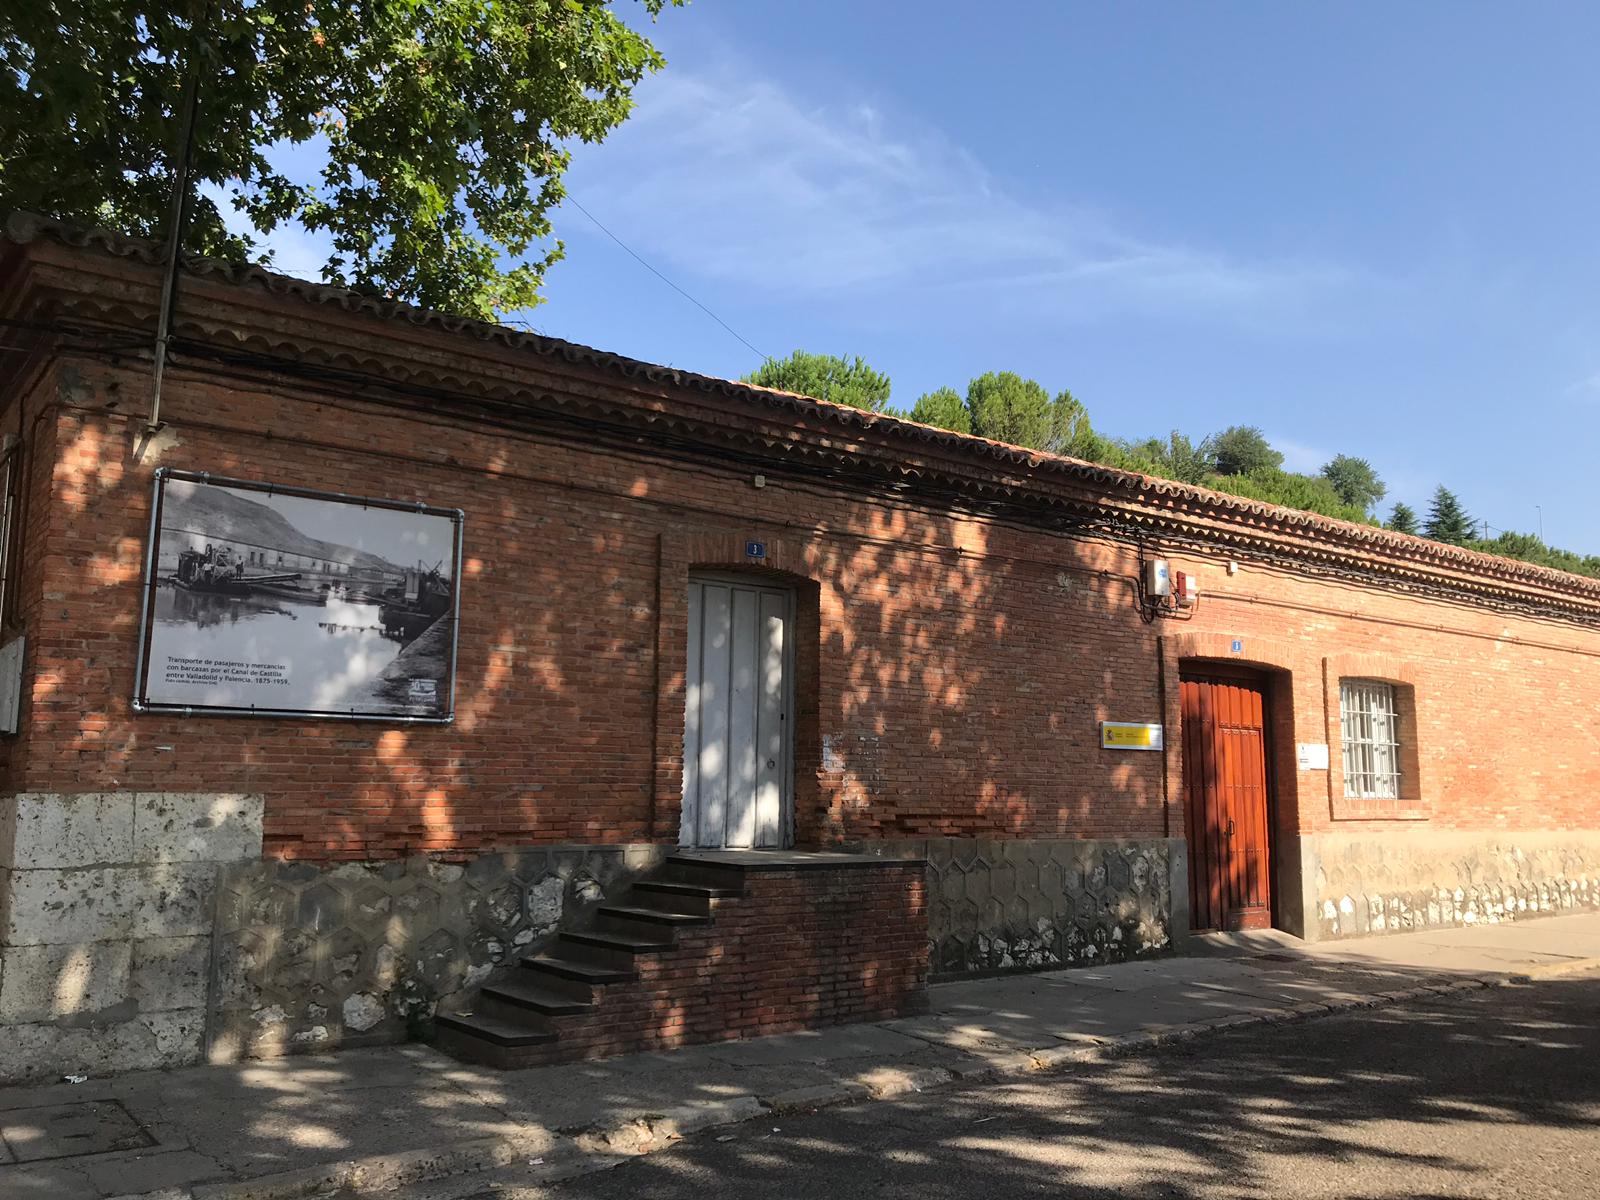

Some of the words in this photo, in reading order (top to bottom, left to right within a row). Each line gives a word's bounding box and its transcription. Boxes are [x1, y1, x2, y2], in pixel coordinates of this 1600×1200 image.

[752, 544, 758, 554] 3
[168, 656, 203, 665] Transporte
[213, 660, 244, 668] pasajeros
[180, 665, 209, 673] barcazas
[186, 672, 218, 681] Valladolid
